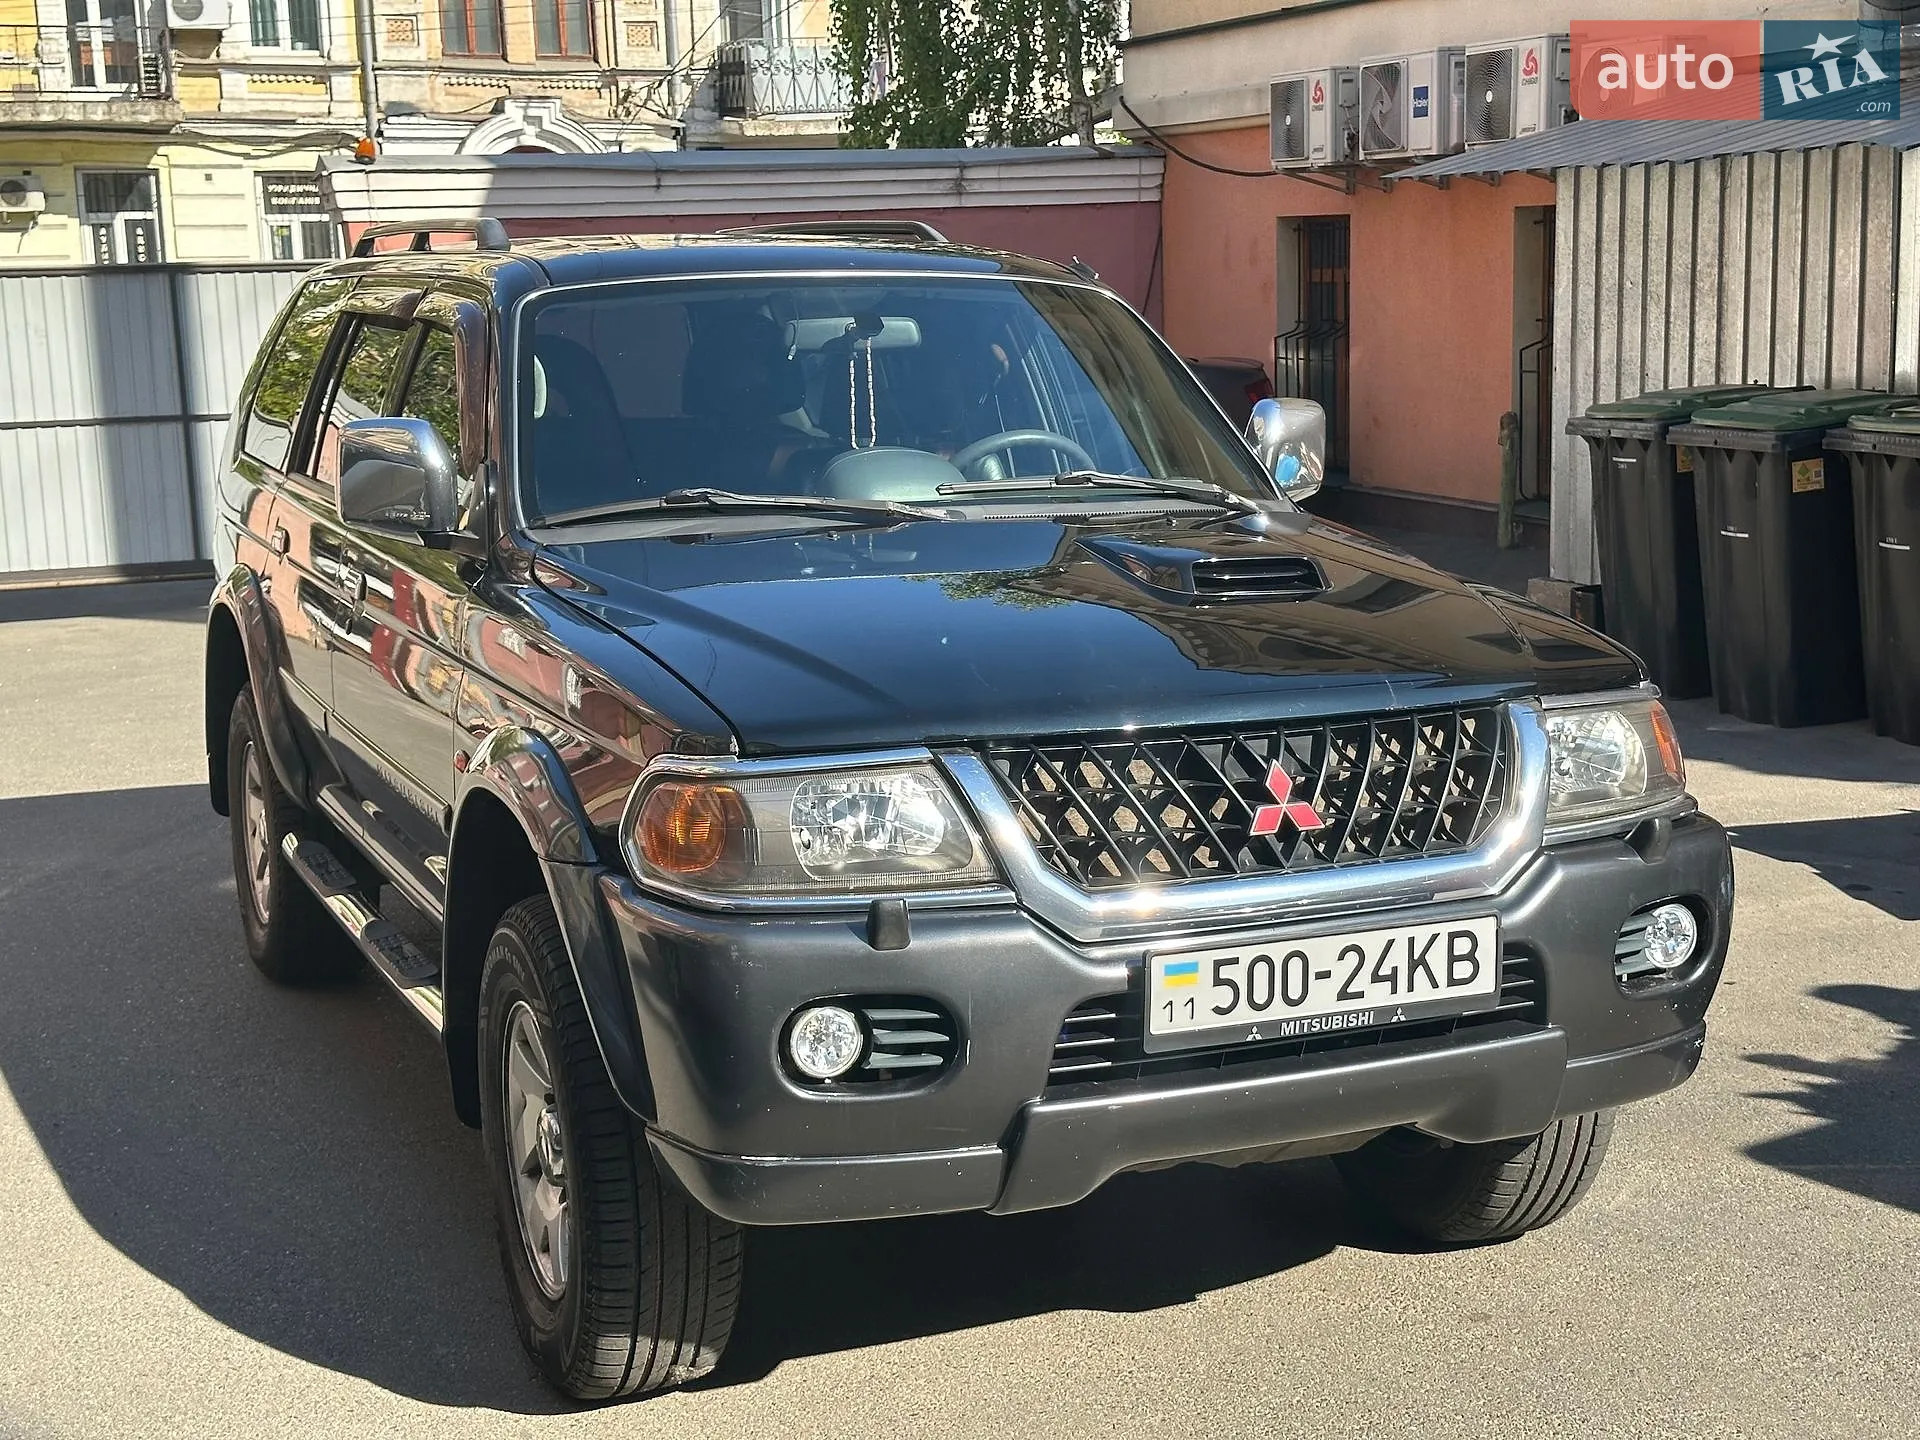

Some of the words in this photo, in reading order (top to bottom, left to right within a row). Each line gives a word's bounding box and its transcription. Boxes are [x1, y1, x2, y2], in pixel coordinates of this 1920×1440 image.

[1212, 929, 1480, 1016] 500-24KB
[1162, 997, 1194, 1022] 11
[1280, 1011, 1374, 1036] MITSUBISHI
